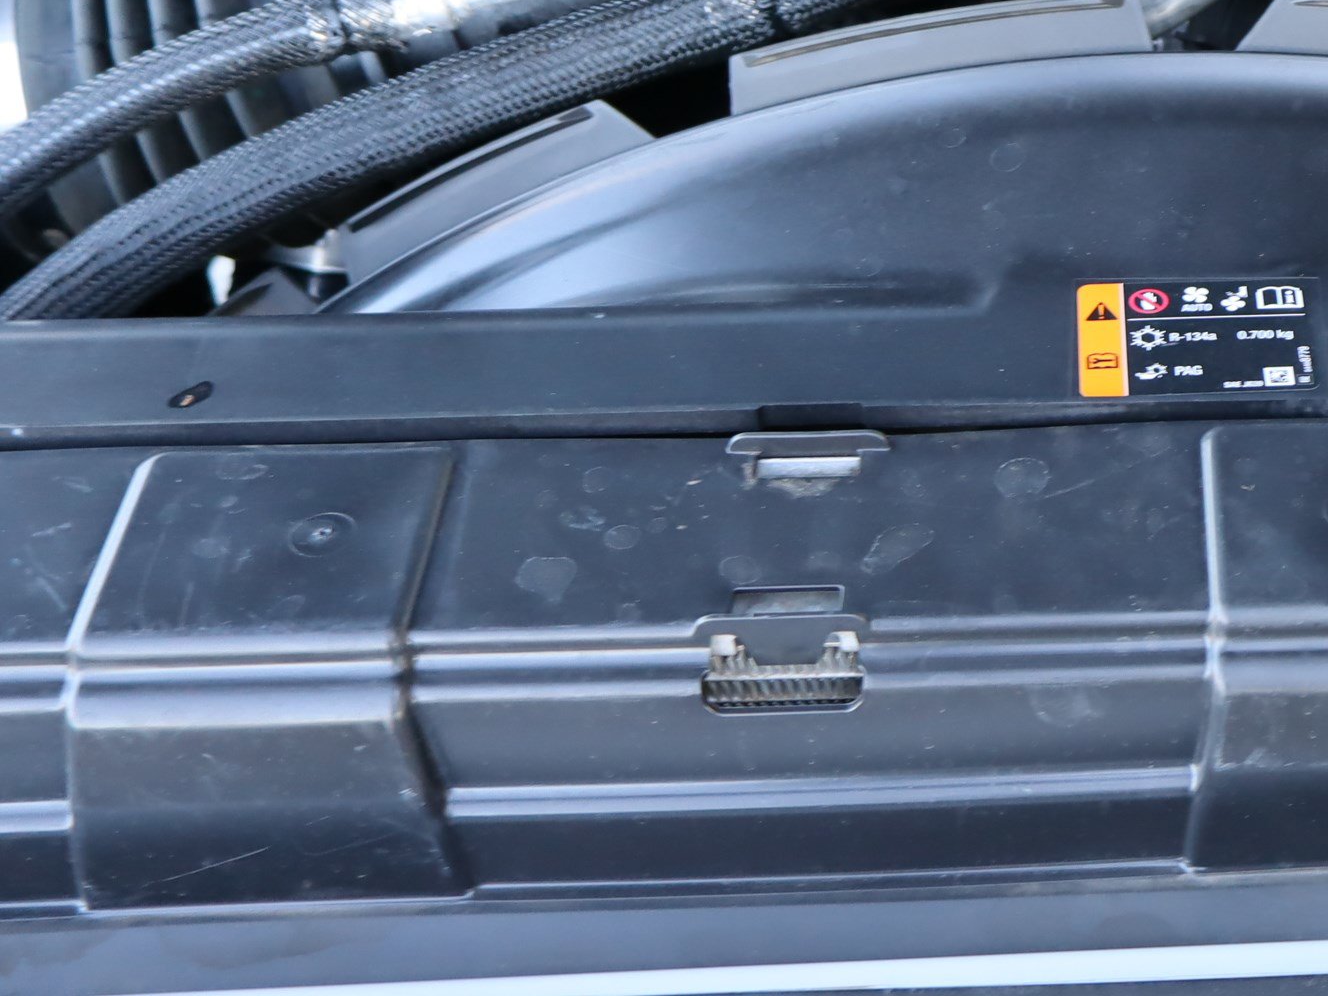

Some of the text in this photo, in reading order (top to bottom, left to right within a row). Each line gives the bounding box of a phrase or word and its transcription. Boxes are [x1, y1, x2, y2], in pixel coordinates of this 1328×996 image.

[1180, 303, 1213, 313] AUTO
[1168, 331, 1218, 342] R-134a
[1276, 328, 1295, 341] kg
[1173, 364, 1204, 377] PAG
